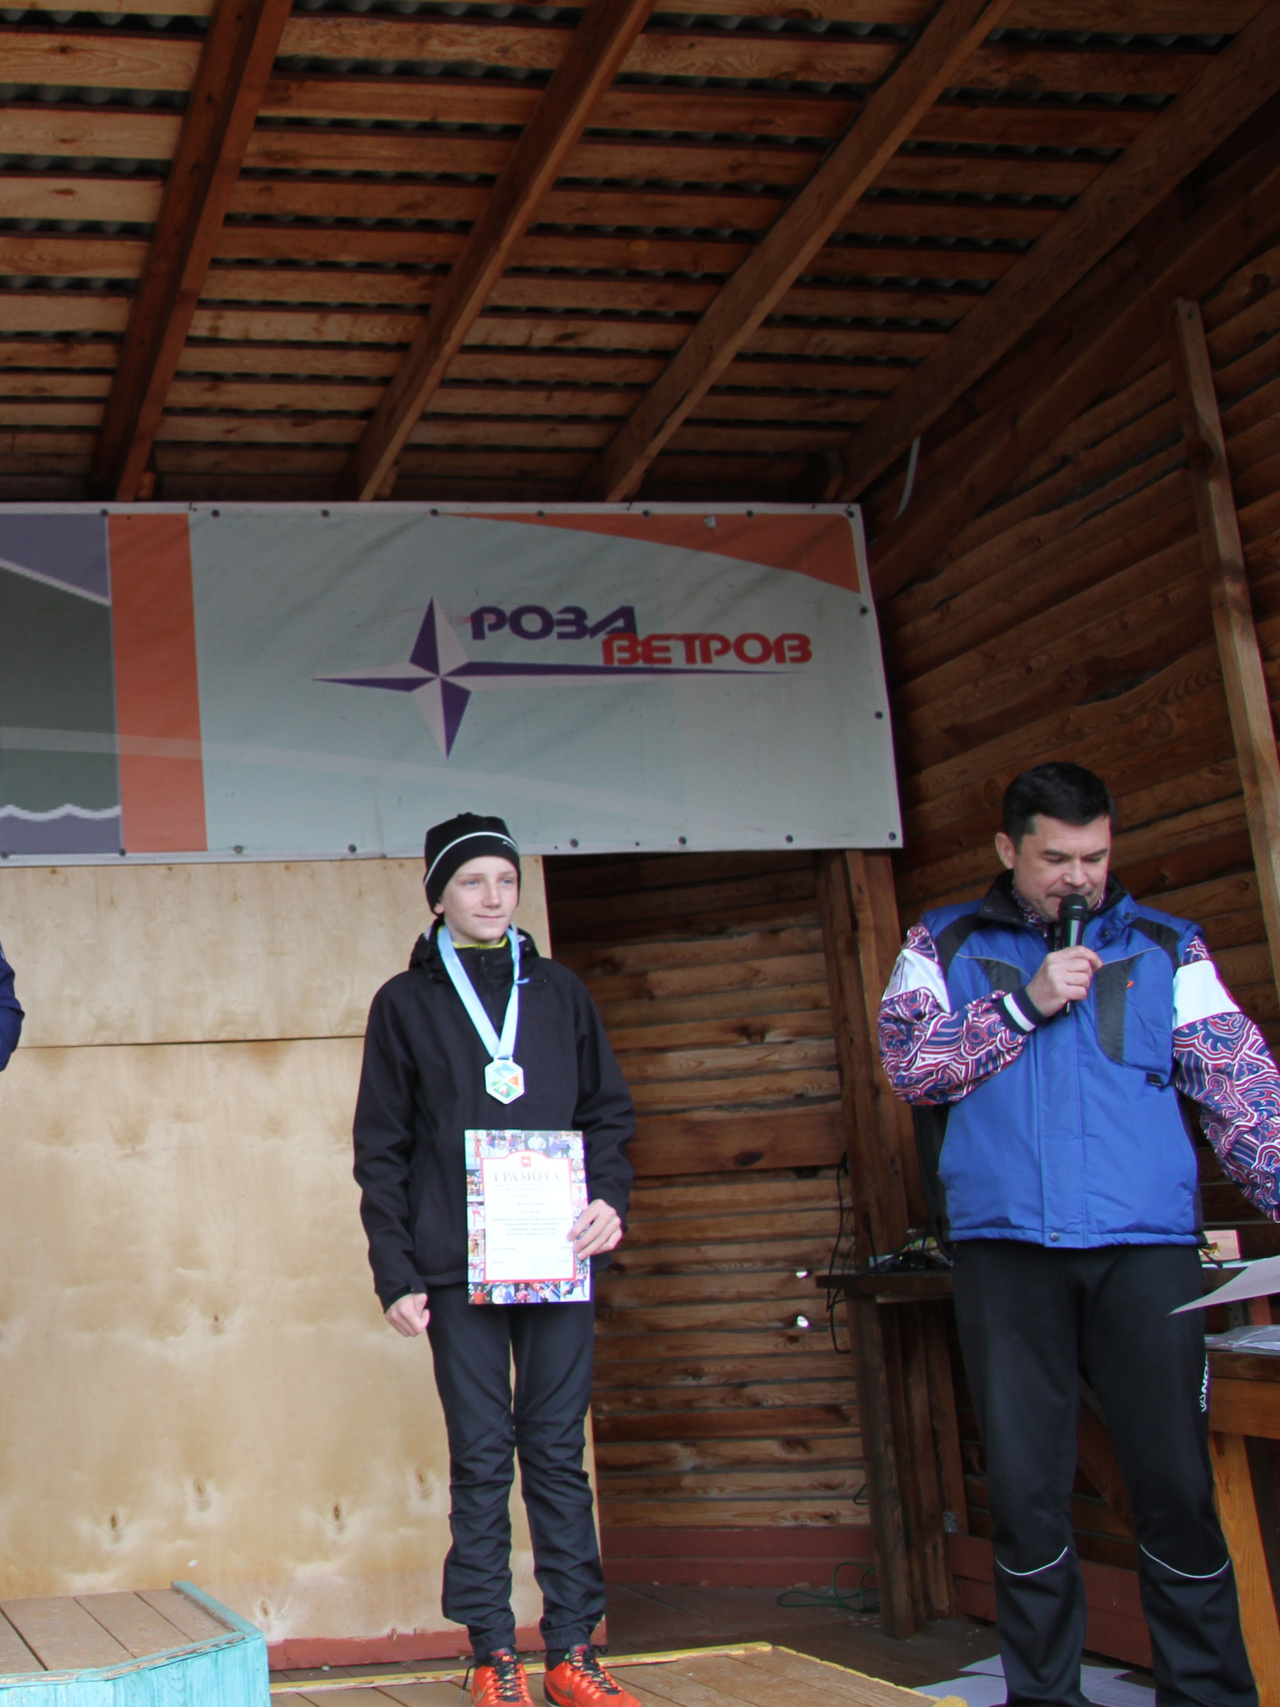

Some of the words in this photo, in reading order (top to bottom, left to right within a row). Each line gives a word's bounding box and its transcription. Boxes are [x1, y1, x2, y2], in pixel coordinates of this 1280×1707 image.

[471, 605, 637, 640] РОЗА
[601, 632, 813, 665] ВЕТРОВ
[493, 1170, 561, 1182] ГРАМОТА
